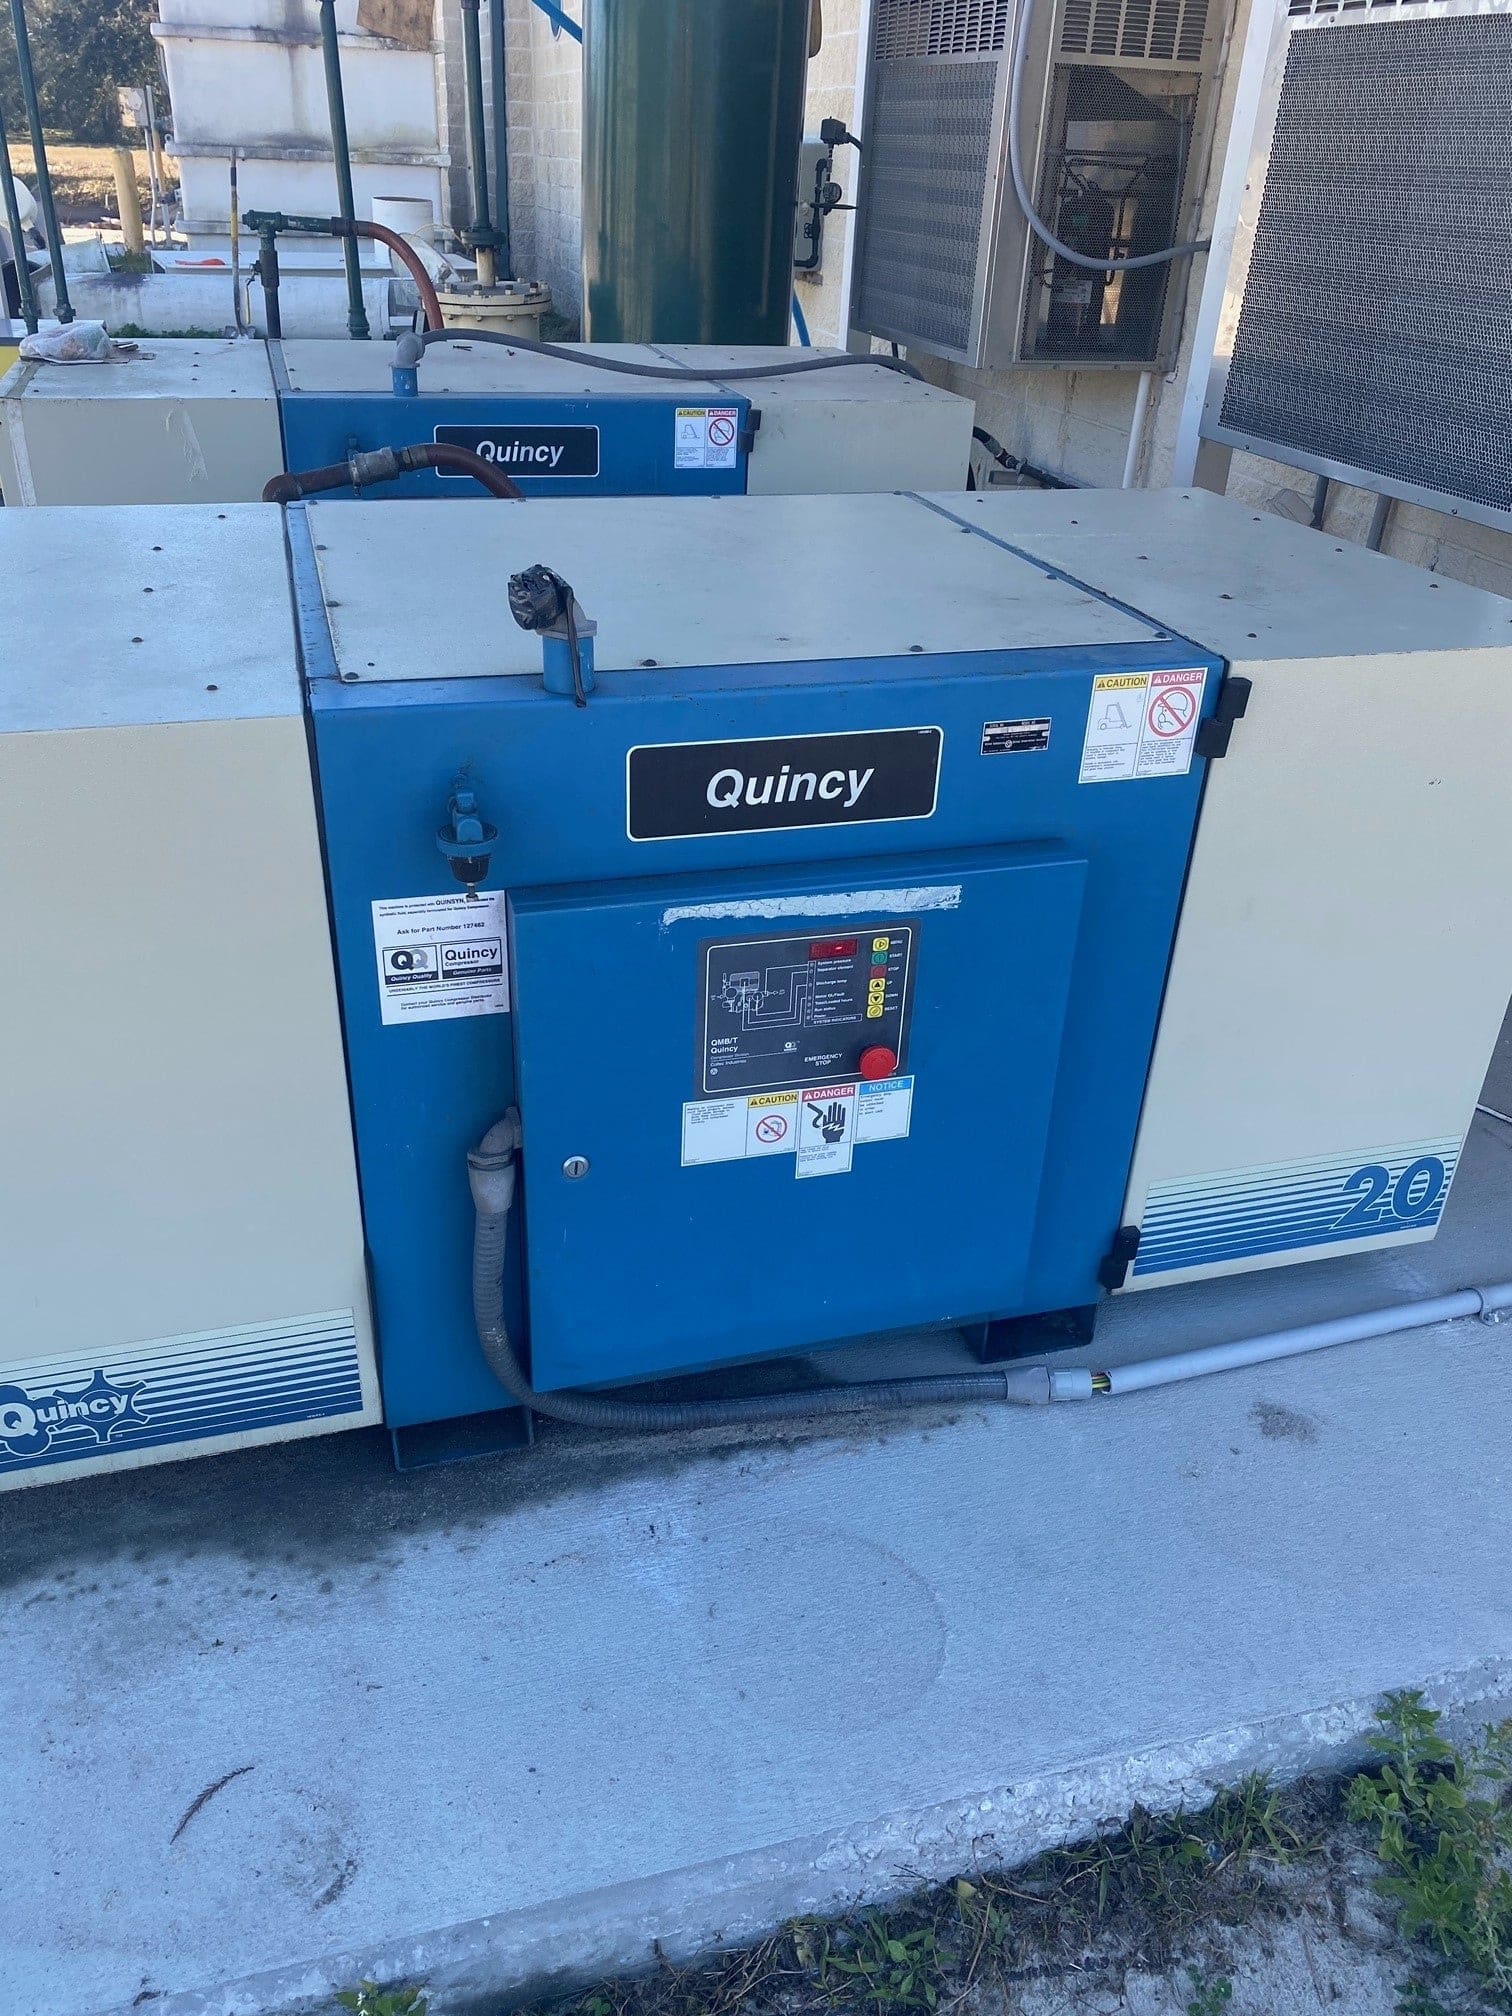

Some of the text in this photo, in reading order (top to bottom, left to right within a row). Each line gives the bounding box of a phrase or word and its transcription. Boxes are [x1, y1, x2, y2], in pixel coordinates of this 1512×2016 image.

[476, 440, 564, 467] Quincy
[1106, 677, 1147, 688] CAUTION
[1162, 672, 1203, 683] DANGER
[706, 765, 875, 808] Quincy
[444, 947, 498, 961] Quincy
[444, 959, 479, 967] Compressor
[478, 966, 492, 974] Parts
[710, 1037, 739, 1046] QMB/T
[710, 1046, 739, 1054] Quincy
[804, 1053, 843, 1063] EMERGENCY
[868, 1080, 904, 1092] NOTICE
[813, 1087, 854, 1099] DANGER
[758, 1094, 798, 1105] CAUTION
[1329, 1157, 1445, 1231] 20
[0, 1395, 128, 1438] Quincy
